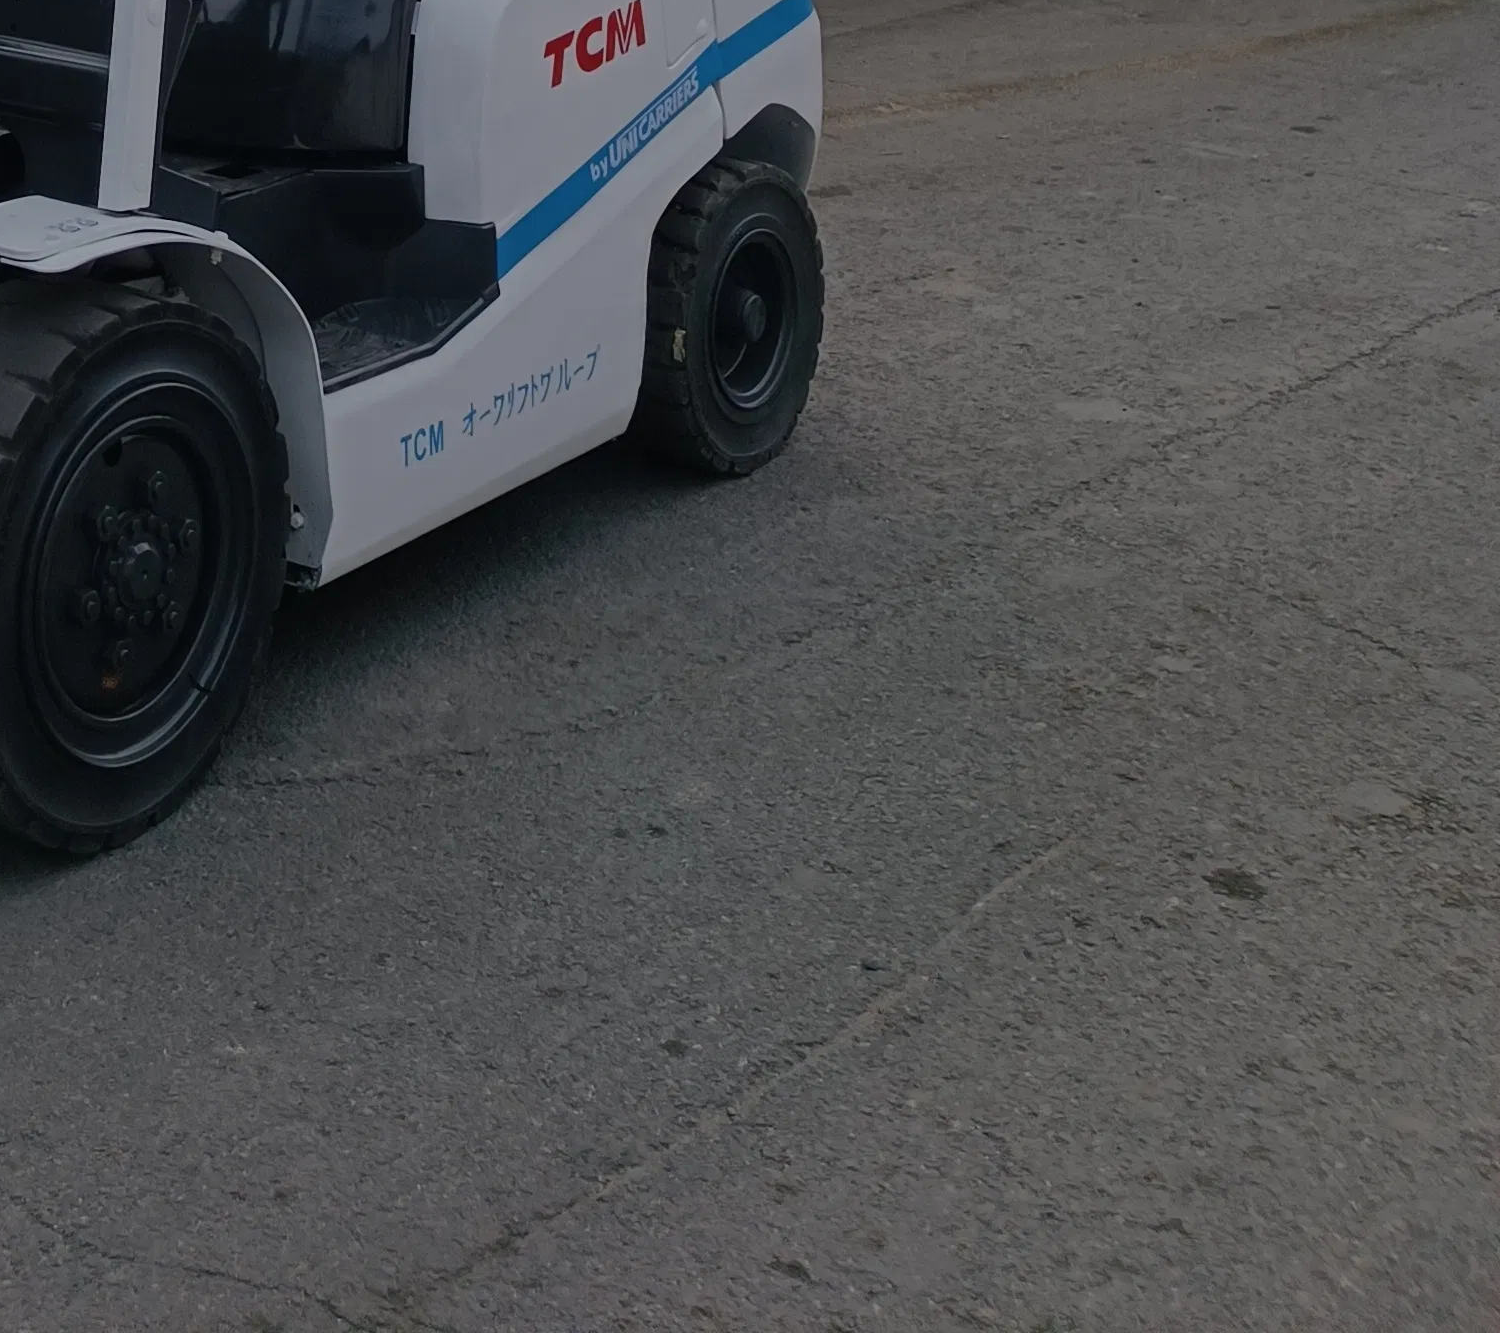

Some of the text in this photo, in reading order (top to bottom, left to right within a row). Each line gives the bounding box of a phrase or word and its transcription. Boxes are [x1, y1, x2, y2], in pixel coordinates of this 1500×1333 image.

[589, 65, 699, 181] by UNICARRIERS
[400, 420, 444, 467] TCM
